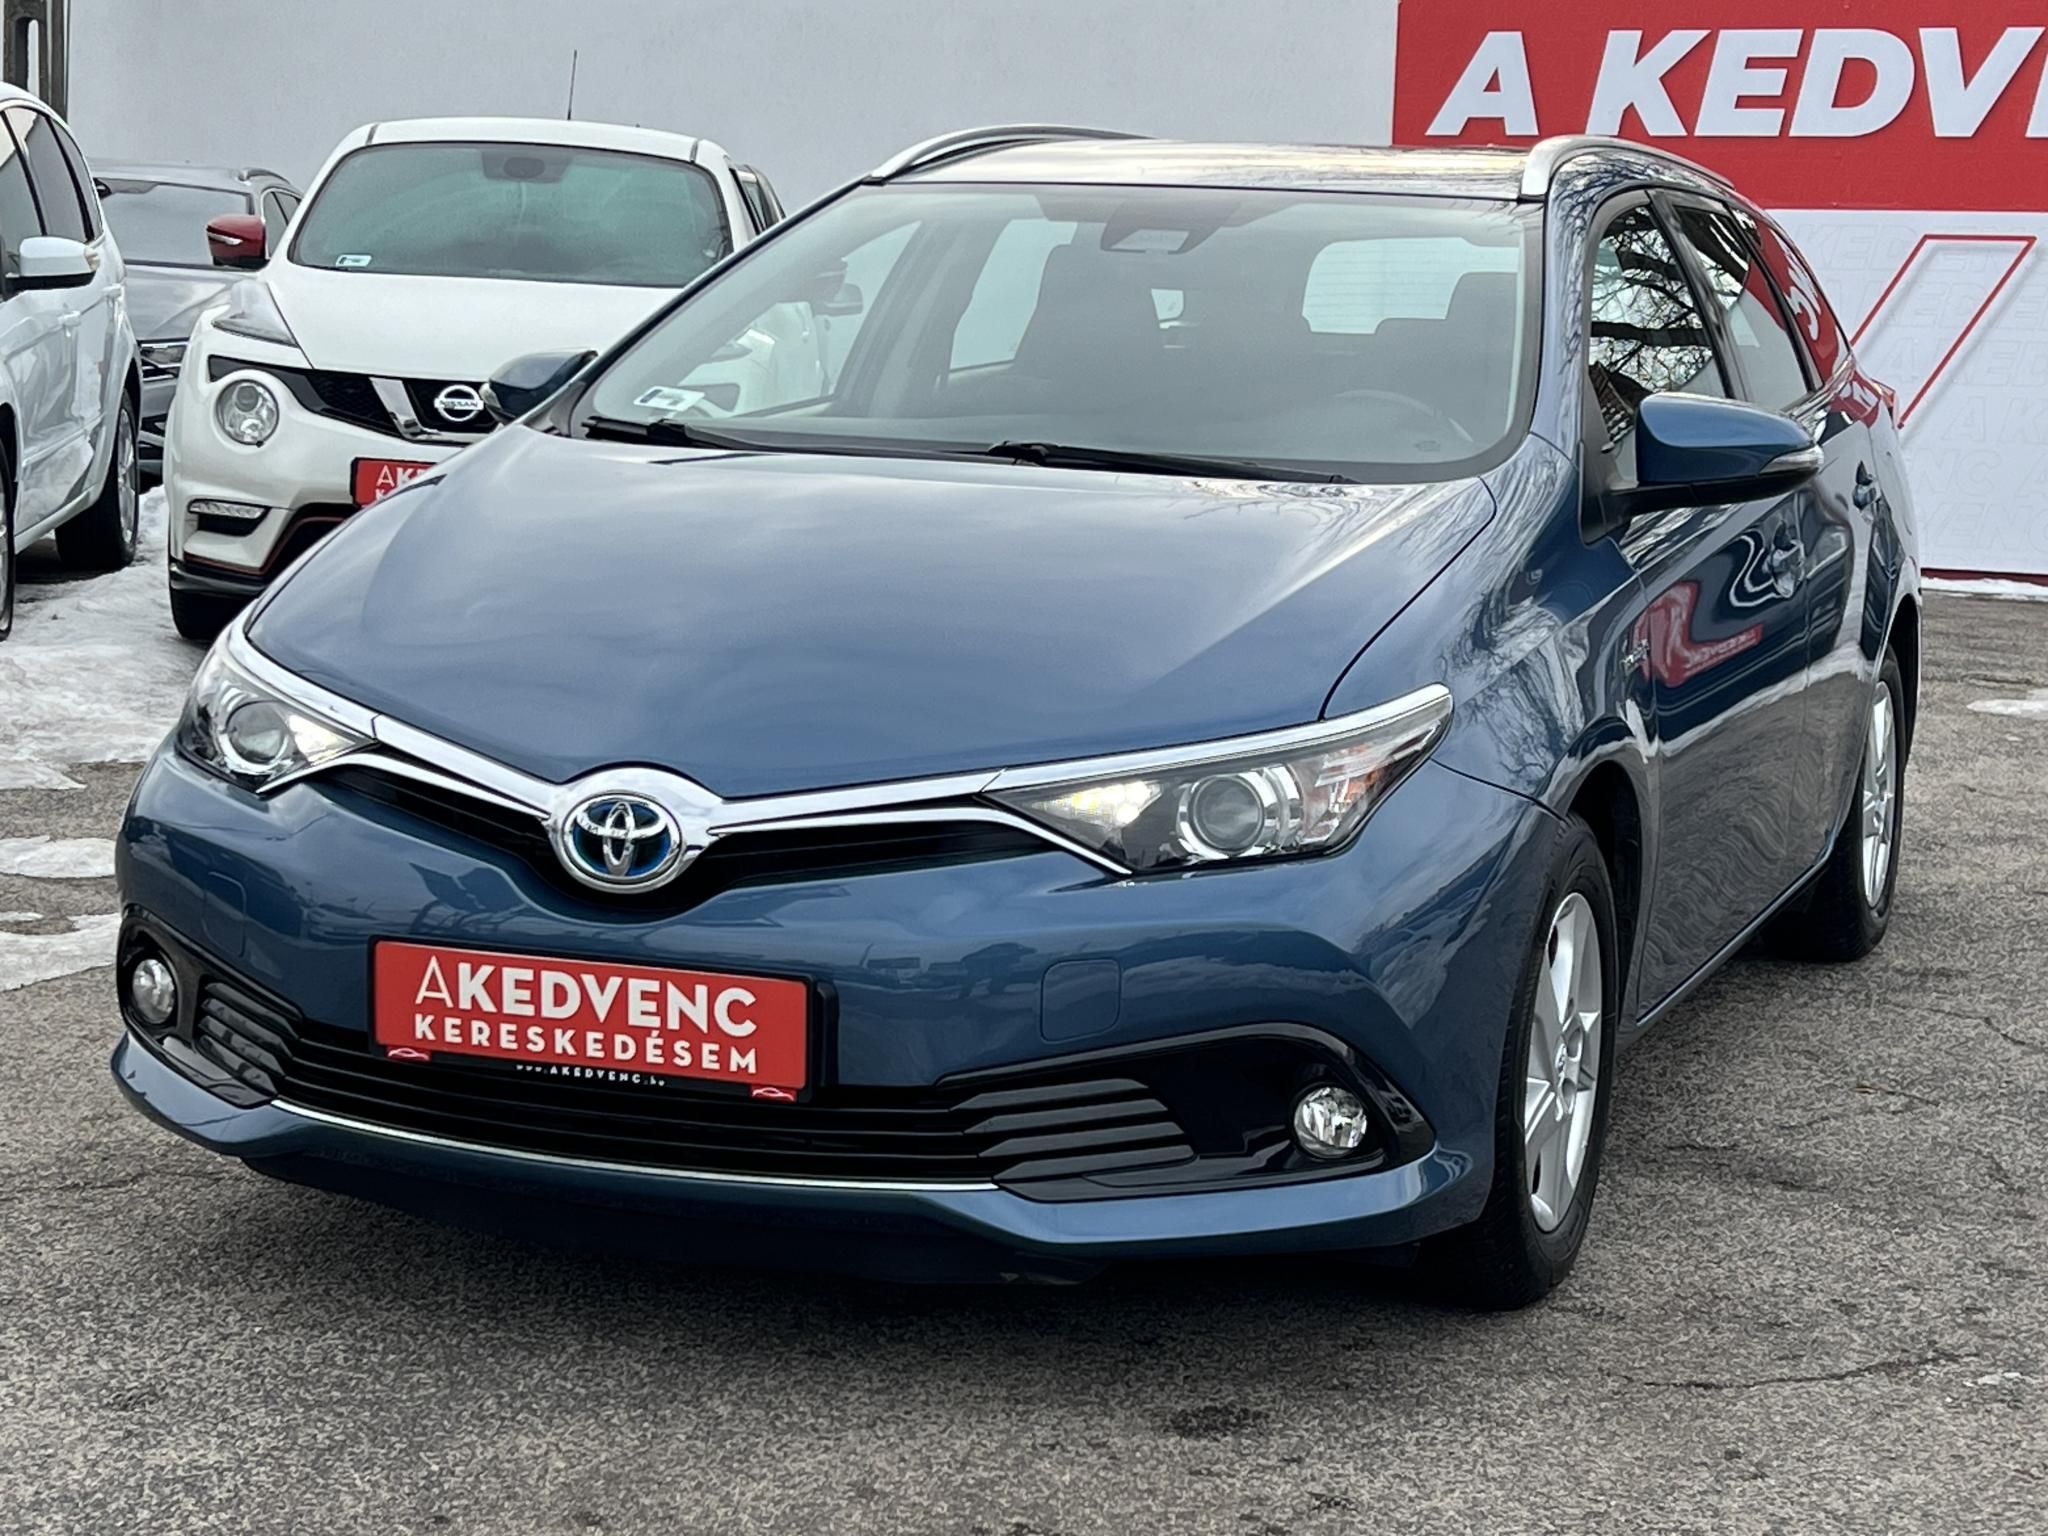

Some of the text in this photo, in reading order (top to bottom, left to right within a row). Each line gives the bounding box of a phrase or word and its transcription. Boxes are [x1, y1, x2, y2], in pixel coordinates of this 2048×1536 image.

[1425, 26, 2048, 139] A KEDV
[439, 399, 478, 409] NISSAN
[414, 1013, 757, 1075] KERESKEDÉSEM
